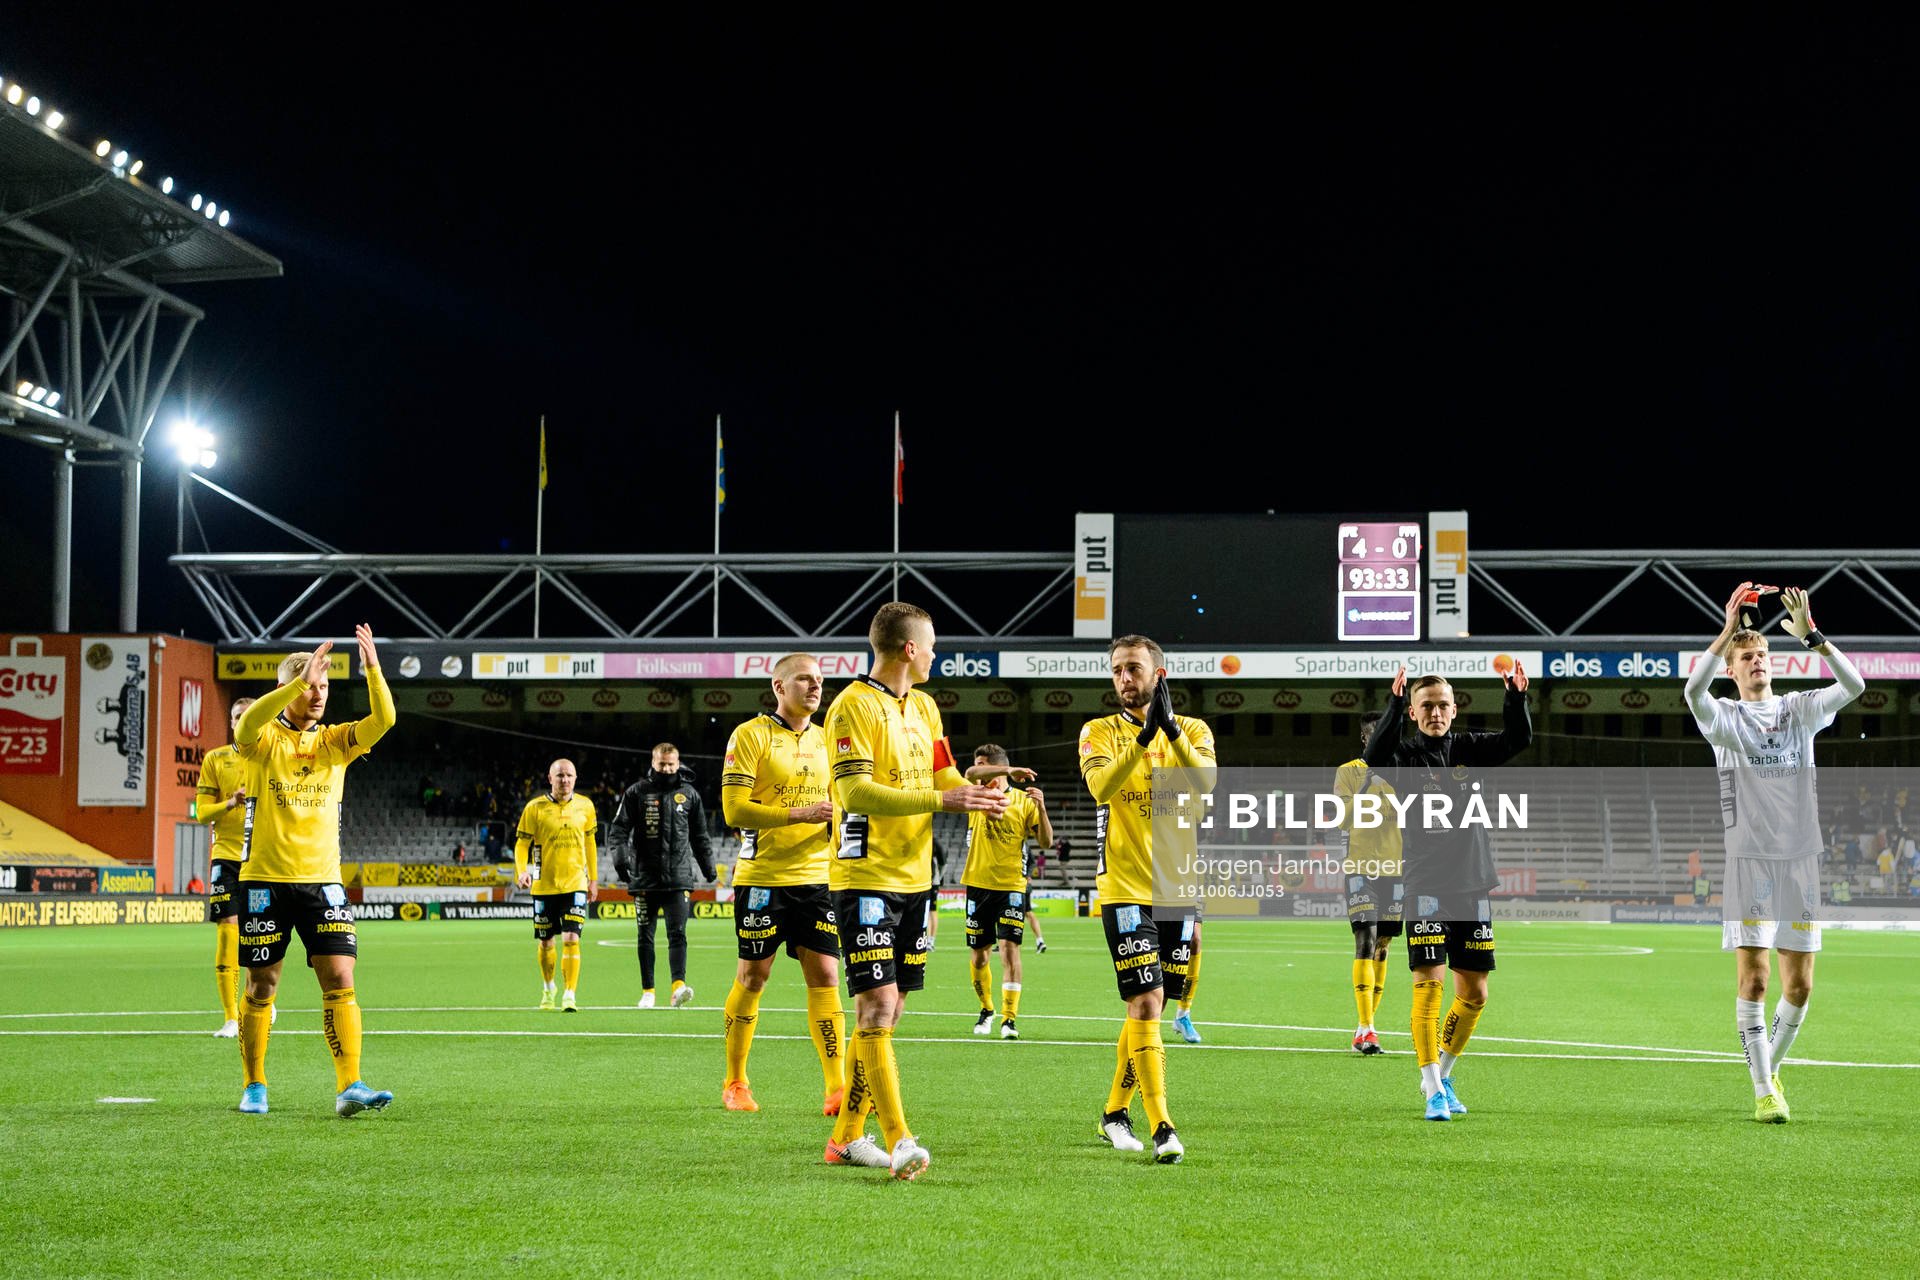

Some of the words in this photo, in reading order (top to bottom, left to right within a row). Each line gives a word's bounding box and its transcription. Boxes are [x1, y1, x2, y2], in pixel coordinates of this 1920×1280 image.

[1352, 538, 1367, 558] 4
[1392, 538, 1407, 558] 0
[1349, 568, 1409, 589] 93:33
[636, 657, 703, 674] Folksam
[940, 653, 991, 677] ellos
[1026, 656, 1112, 675] Sparbank
[1166, 656, 1215, 673] härad
[1295, 656, 1400, 676] Sparbanken
[1407, 656, 1487, 676] Sjuhärad
[1550, 652, 1602, 677] ellos
[1617, 652, 1671, 677] ellos
[101, 870, 155, 892] Assemblin
[0, 901, 38, 926] ATCH:
[39, 901, 56, 925] IF
[56, 901, 118, 926] ELFSBORG
[125, 900, 146, 923] IFK
[147, 896, 205, 923] GÖTEBORG
[324, 906, 354, 921] ellos
[445, 907, 457, 917] VI
[459, 906, 533, 919] TILLSAMMANS
[1516, 908, 1580, 918] DJURPARK
[245, 917, 276, 933] ellos
[743, 913, 771, 928] ellos
[1414, 920, 1442, 934] ellos
[240, 932, 283, 946] RAMIRENT
[739, 925, 778, 940] RAMIRENT
[856, 928, 891, 947] ellos
[1409, 934, 1446, 946] RAMIRENT
[252, 947, 270, 962] 20
[752, 941, 765, 954] 17
[1118, 937, 1151, 955] ellos
[1424, 946, 1437, 959] 11
[1115, 951, 1158, 972] RAMIRENT
[872, 963, 883, 979] 8
[1137, 966, 1153, 984] 16
[324, 1008, 344, 1058] FRISTADS
[816, 1019, 838, 1059] FRISTADS
